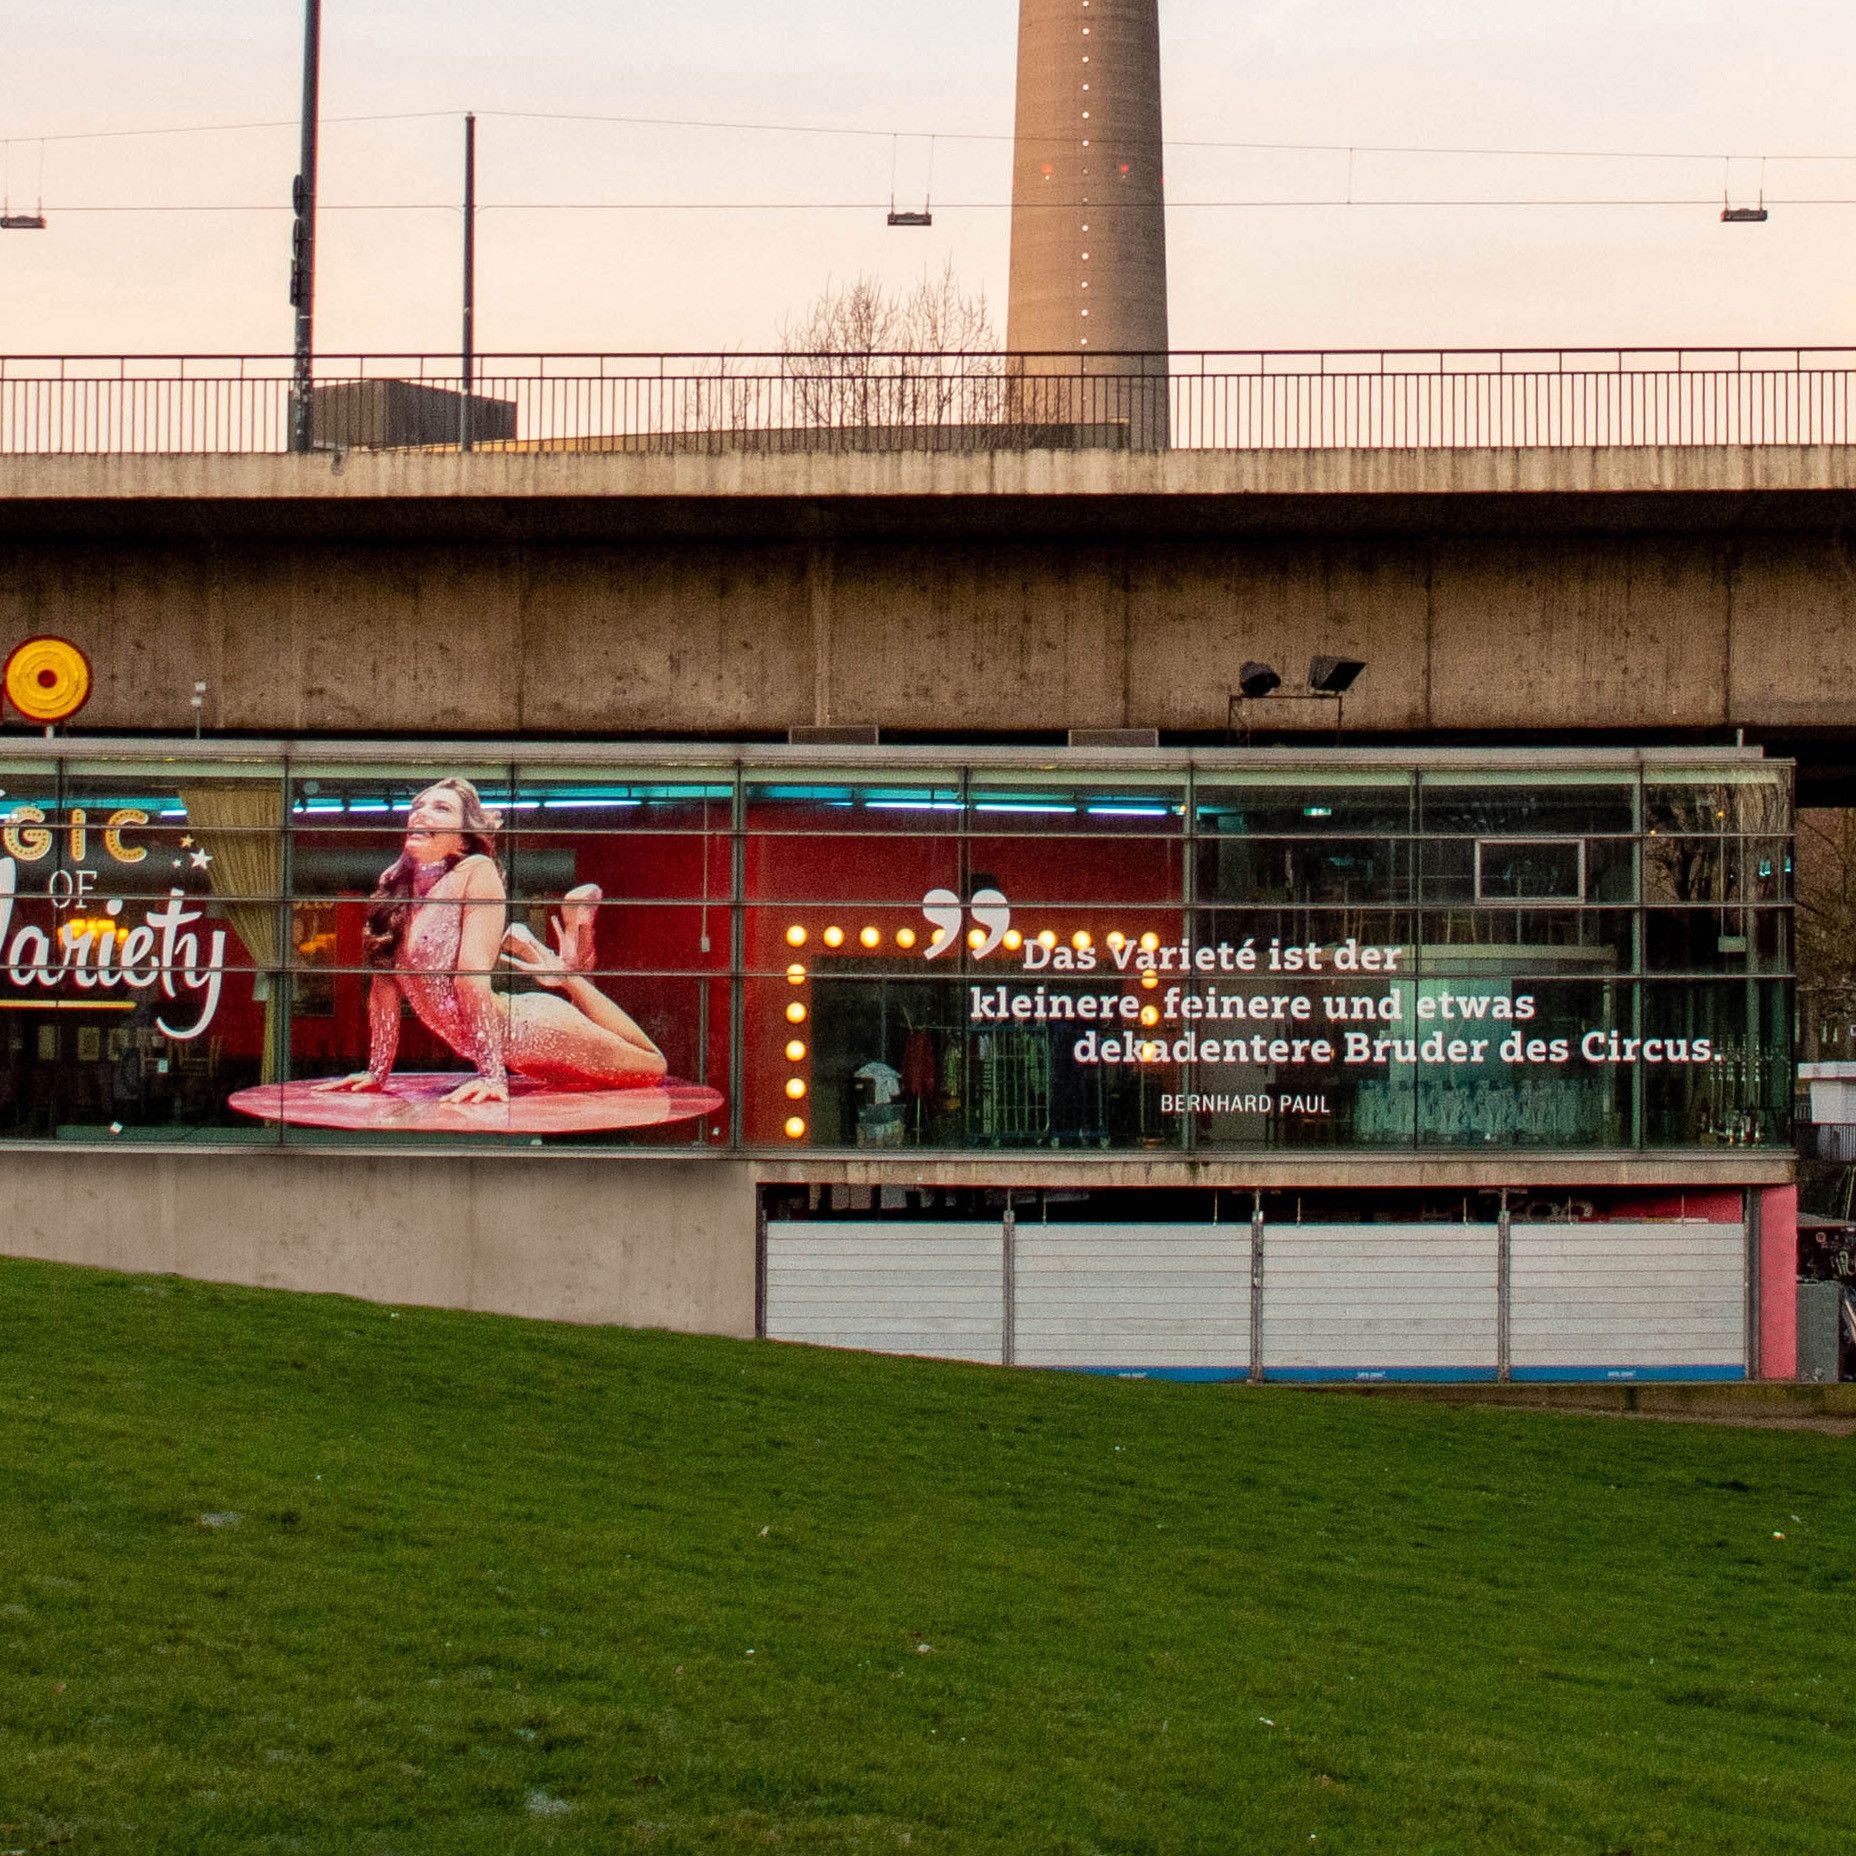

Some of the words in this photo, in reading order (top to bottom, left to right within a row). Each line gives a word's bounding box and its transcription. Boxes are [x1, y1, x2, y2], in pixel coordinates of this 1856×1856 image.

[48, 869, 98, 910] OF
[1023, 938, 1097, 971] Das
[1109, 937, 1257, 971] Varieté
[1269, 938, 1323, 971] ist
[1333, 938, 1403, 971] der
[970, 986, 1150, 1024] kleinere,
[1163, 986, 1311, 1020] feinere
[1323, 988, 1402, 1021] und
[1416, 990, 1536, 1021] etwas
[1073, 1030, 1332, 1064] dekadentere
[1343, 1031, 1489, 1064] Bruder
[1499, 1031, 1569, 1064] des
[1580, 1031, 1723, 1064] Circus.
[1160, 1093, 1272, 1114] BERNHARD
[1279, 1093, 1331, 1114] PAUL
